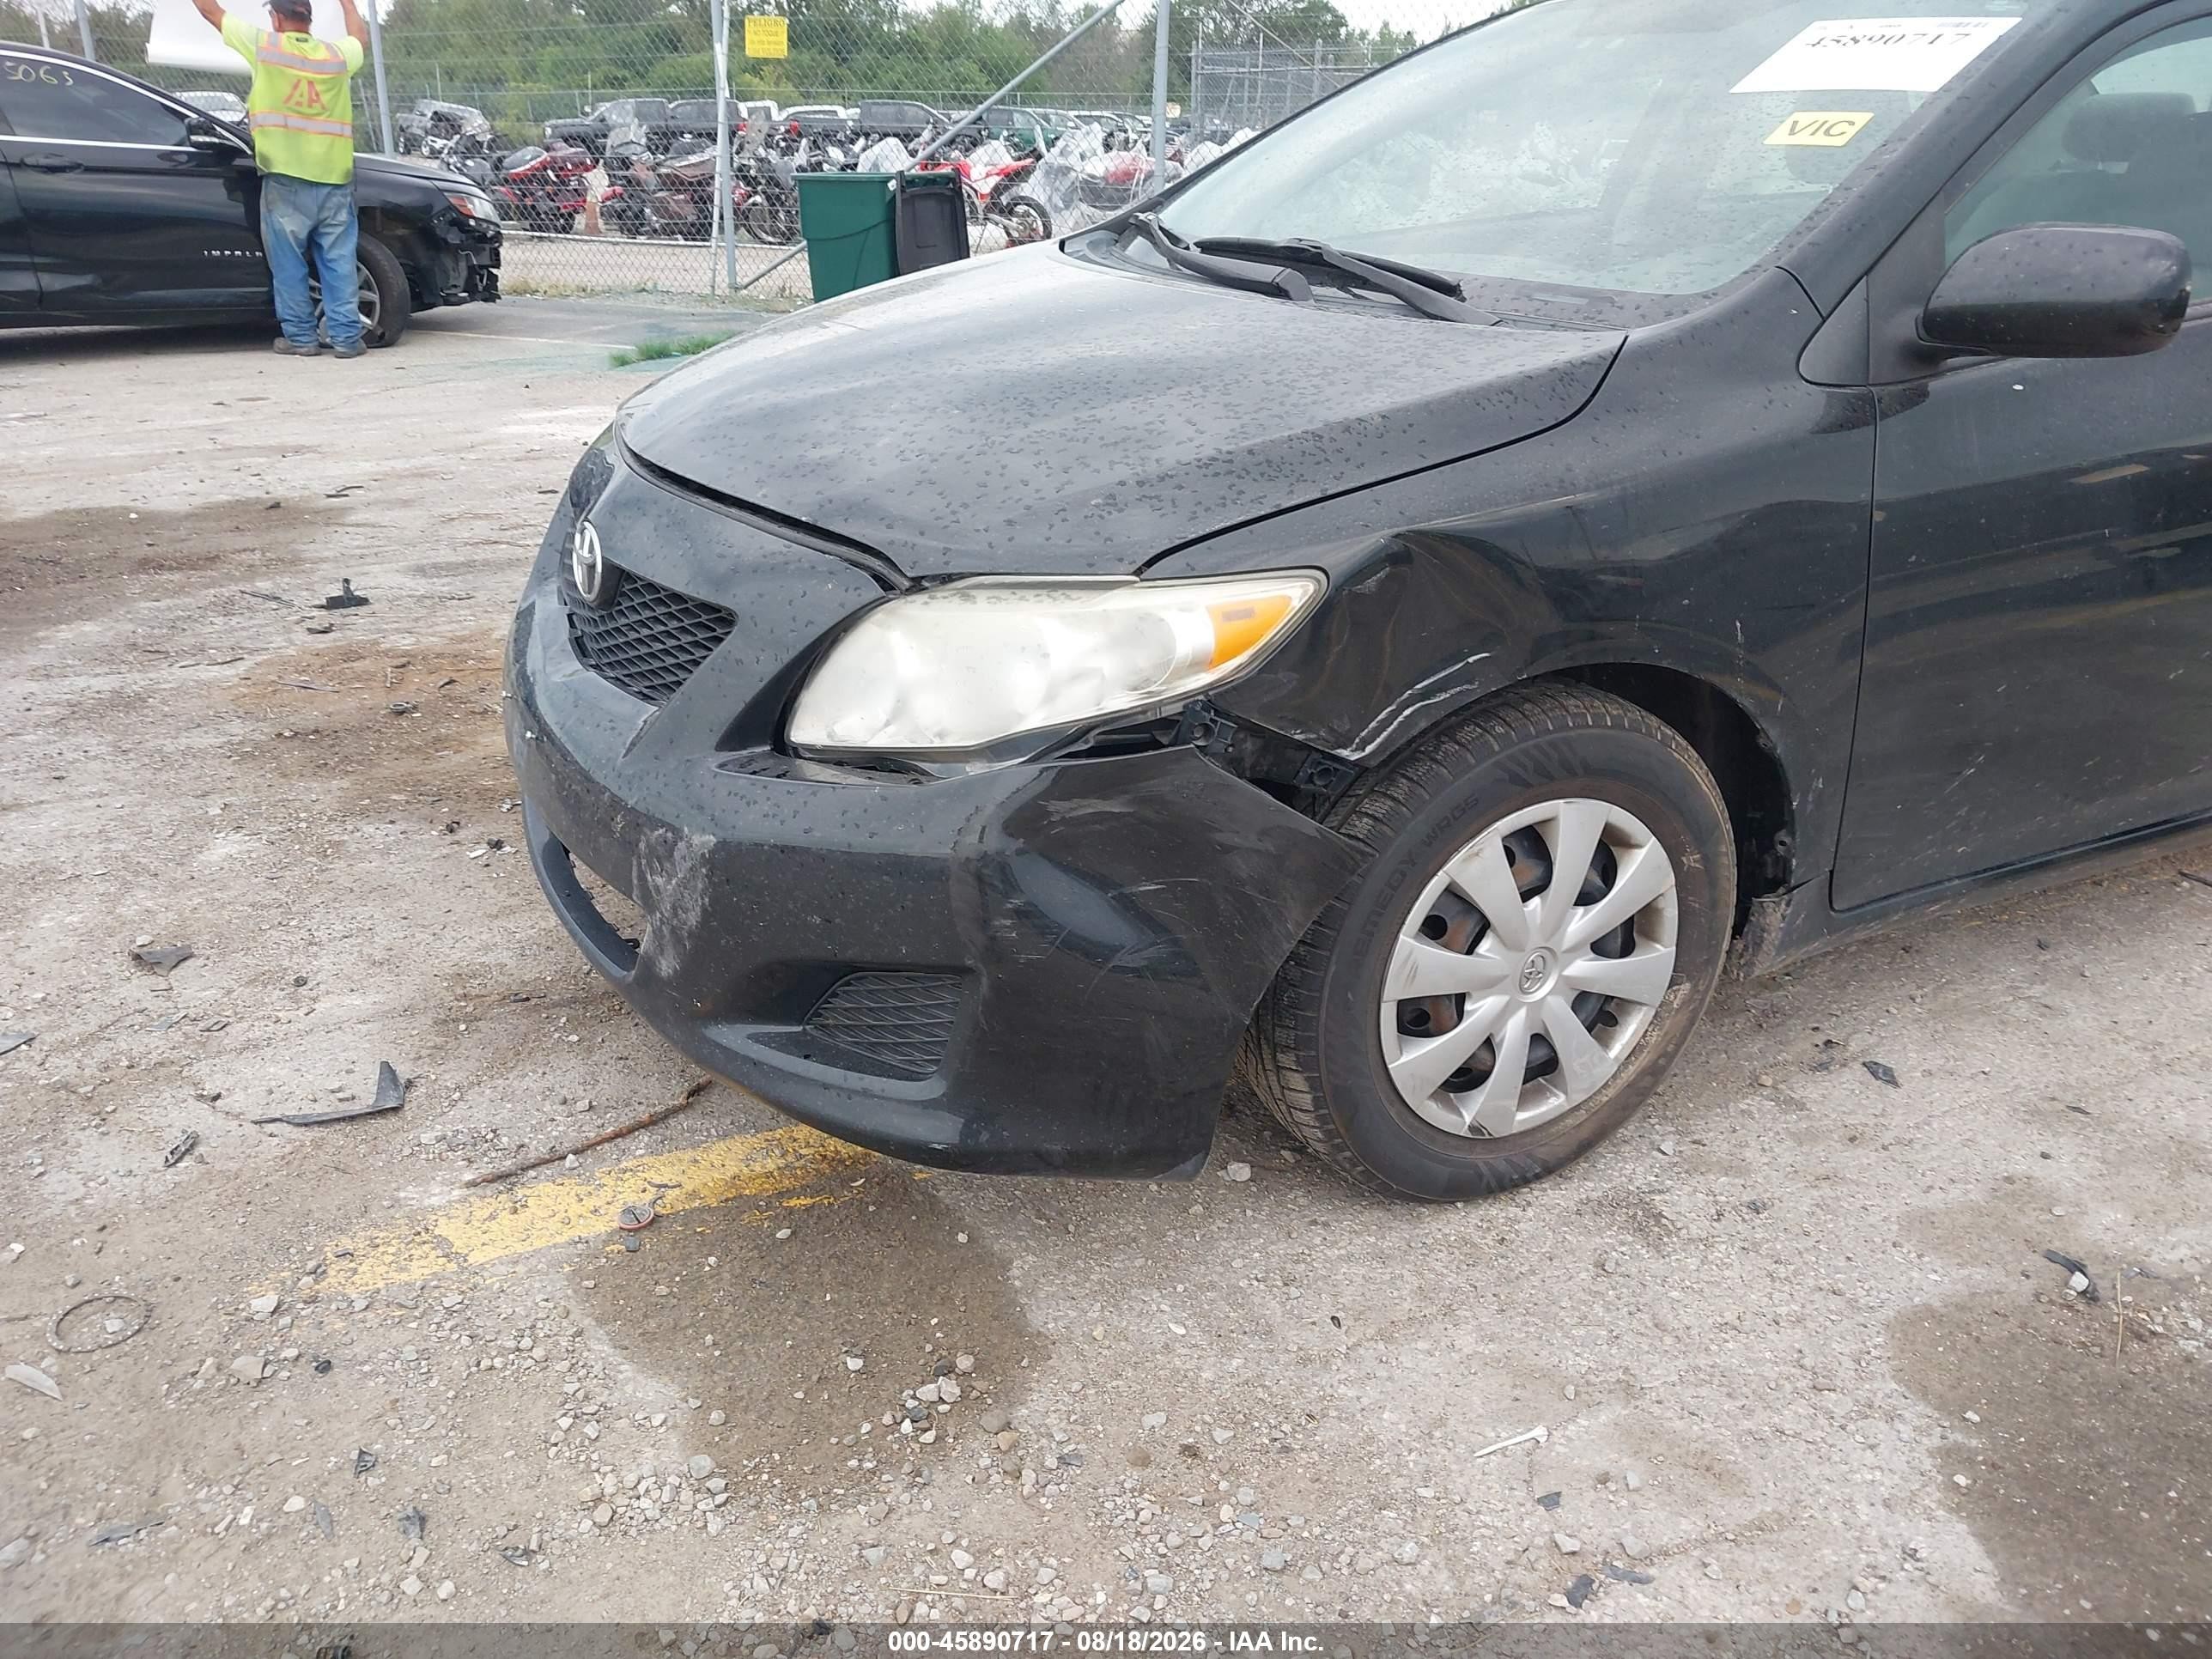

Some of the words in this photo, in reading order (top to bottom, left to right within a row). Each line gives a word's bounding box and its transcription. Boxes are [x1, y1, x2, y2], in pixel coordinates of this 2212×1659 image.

[747, 17, 785, 27] PELIGRO
[1805, 33, 1972, 49] 45890717
[1788, 120, 1856, 137] VIC
